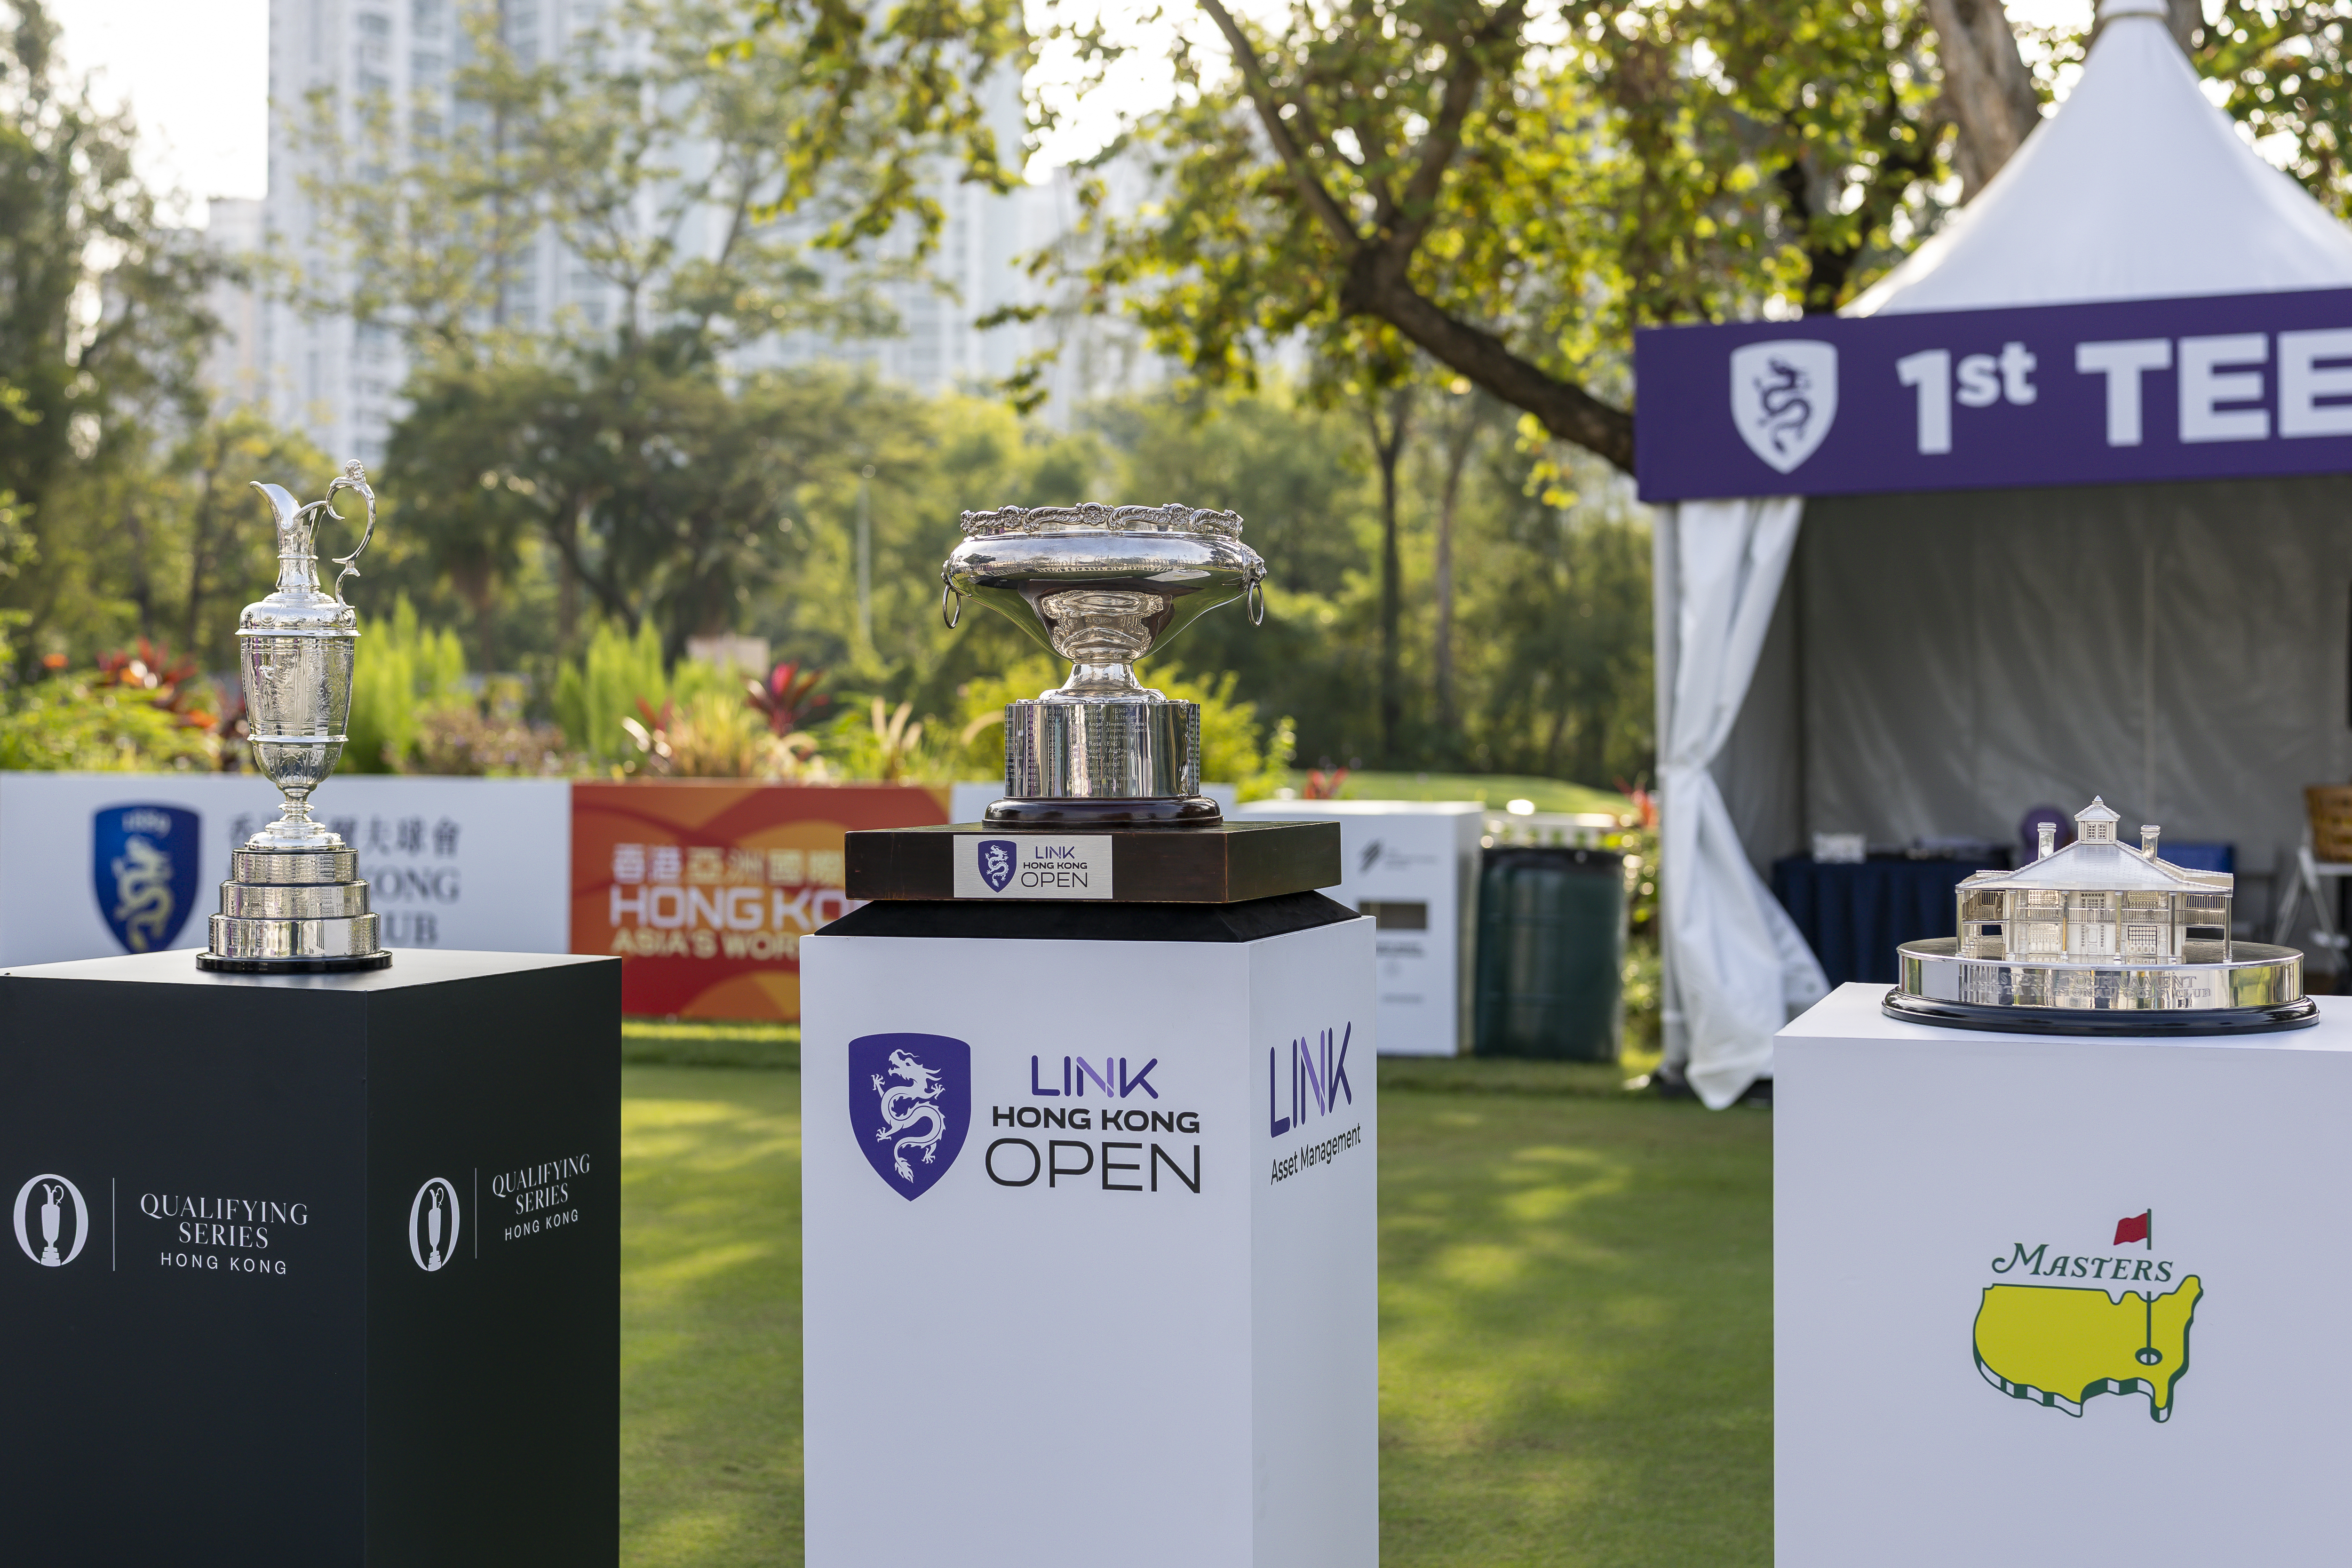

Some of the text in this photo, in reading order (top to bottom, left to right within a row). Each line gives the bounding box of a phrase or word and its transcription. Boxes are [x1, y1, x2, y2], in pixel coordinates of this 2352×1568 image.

[1897, 326, 2352, 455] 1st TEE
[1035, 846, 1075, 859] LINK
[1021, 872, 1088, 888] OPEN
[610, 884, 873, 931] HONG KO
[612, 927, 718, 958] ASIA'S
[2060, 975, 2197, 988] TOURNAMENT
[2174, 988, 2211, 998] CLUB
[1032, 1055, 1159, 1099] LINK
[1270, 1021, 1351, 1138] LINK
[993, 1106, 1200, 1134] HONG KONG
[985, 1137, 1201, 1194] OPEN
[1271, 1122, 1361, 1186] Asset Management
[493, 1154, 590, 1198] QUALIFYING
[141, 1193, 308, 1226] QUALIFYING
[516, 1183, 568, 1215] SERIES
[179, 1221, 269, 1249] SERIES
[505, 1209, 578, 1241] HONG KONG
[161, 1252, 286, 1275] HONG KONG
